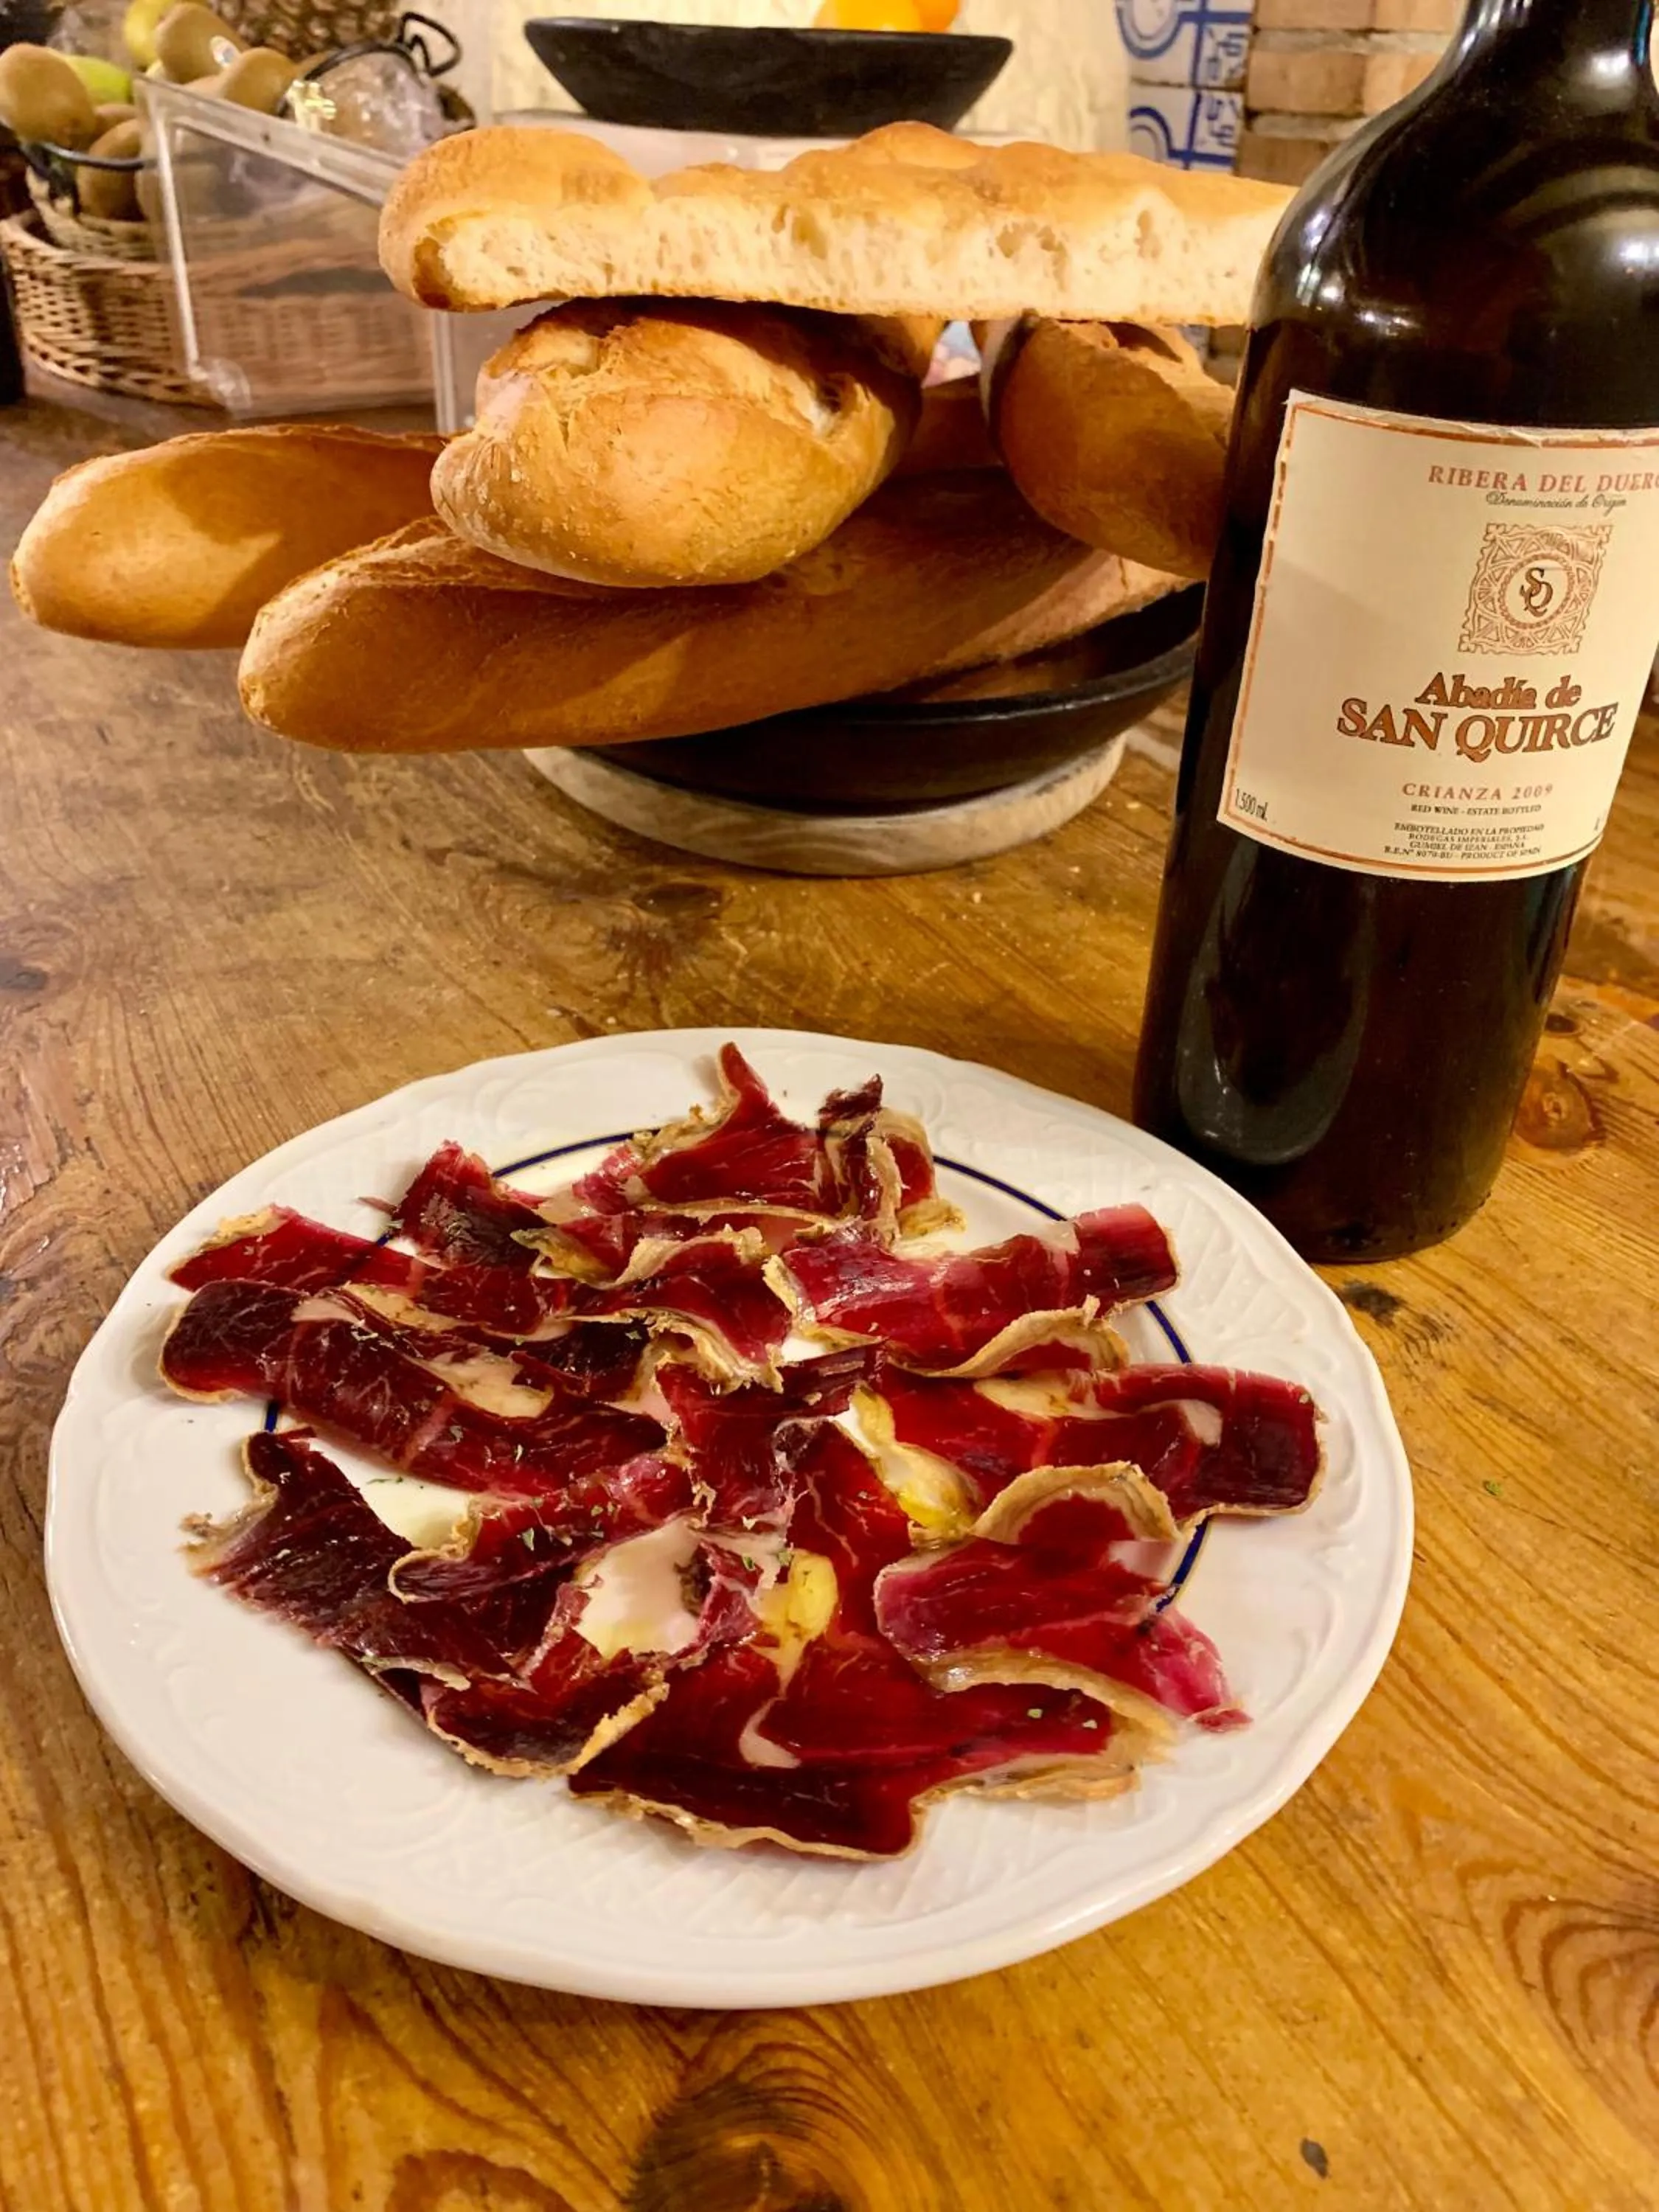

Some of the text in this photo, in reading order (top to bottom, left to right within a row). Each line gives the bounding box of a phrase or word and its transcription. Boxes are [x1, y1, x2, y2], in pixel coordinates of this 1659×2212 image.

[1427, 465, 1527, 492] RIBERA
[1537, 474, 1587, 493] DEL
[1414, 672, 1582, 710] Abadía de
[1337, 697, 1618, 763] SAN QUIRCE
[1402, 782, 1554, 801] CRIANZA 2009
[1411, 804, 1432, 813] RED
[1434, 806, 1459, 815] WINE
[1467, 807, 1498, 815] ESTATE
[1502, 804, 1542, 815] BOTTLED
